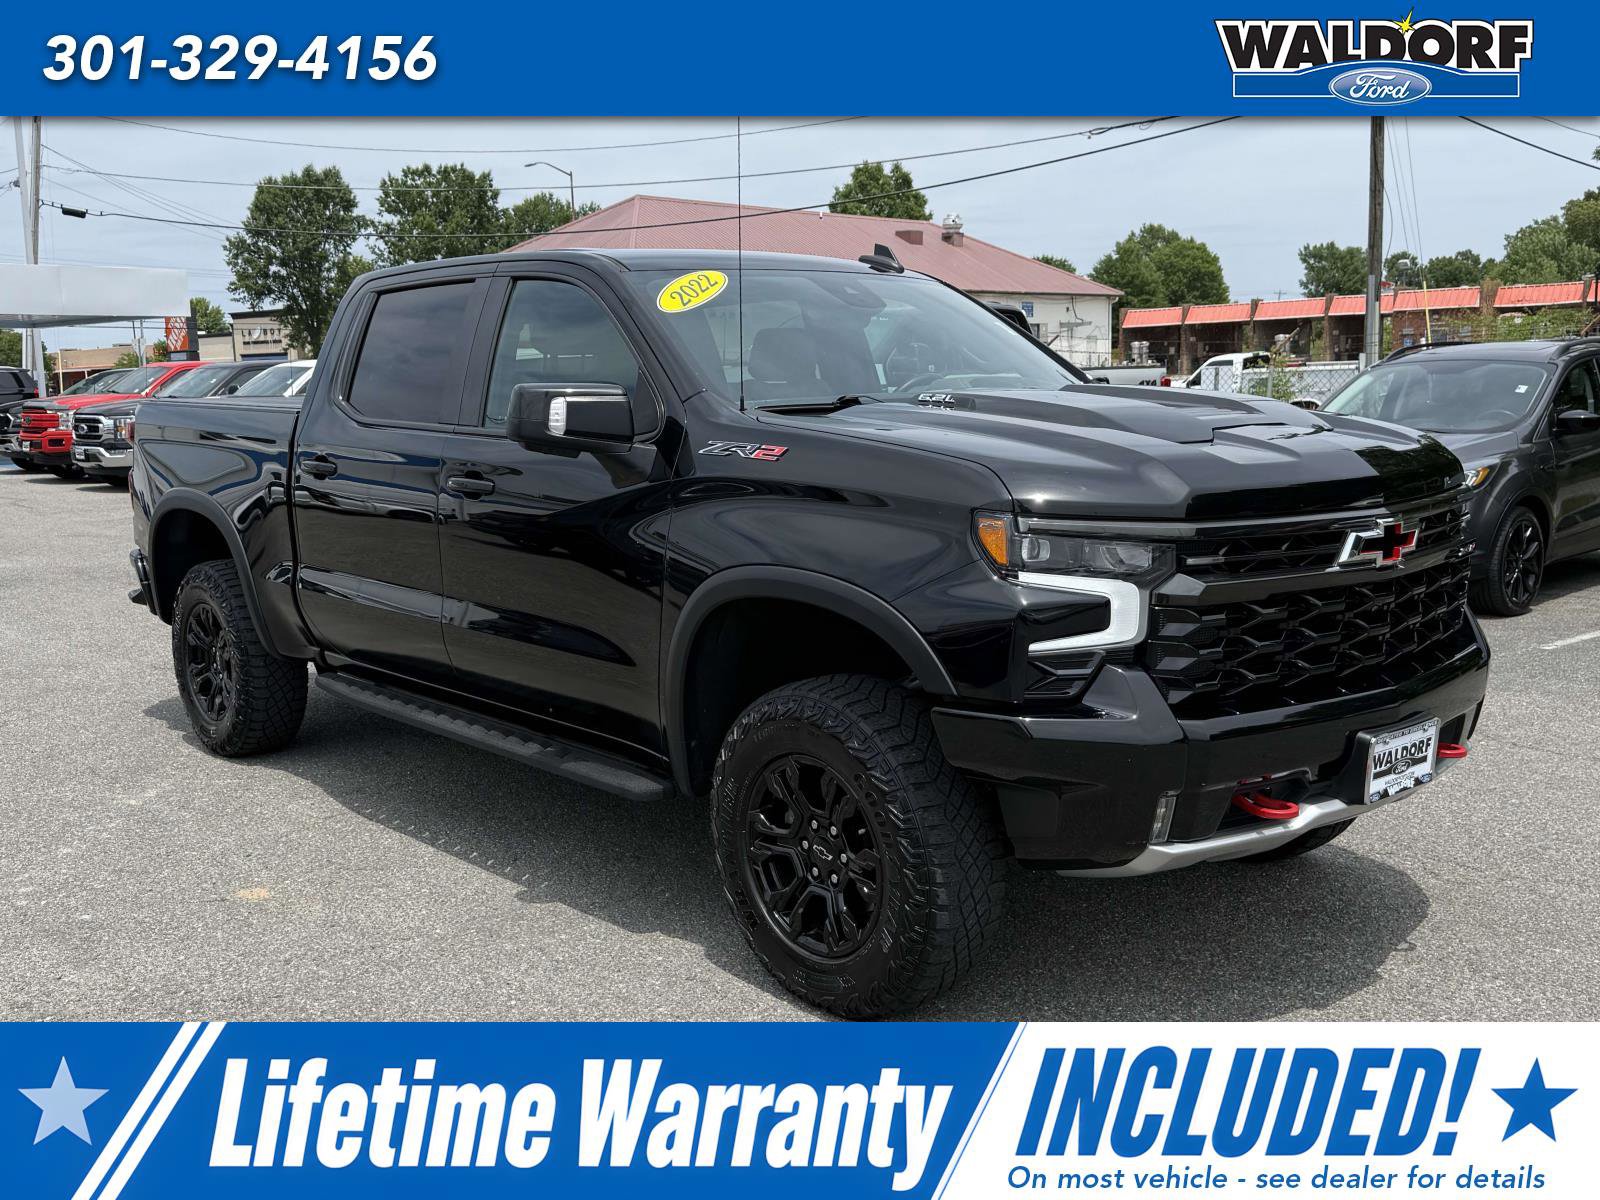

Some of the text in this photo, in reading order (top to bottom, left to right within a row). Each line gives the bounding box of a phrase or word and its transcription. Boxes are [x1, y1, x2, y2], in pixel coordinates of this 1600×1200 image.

[670, 274, 718, 306] 2022
[698, 440, 789, 461] ZR2
[1373, 737, 1432, 771] WALDORF
